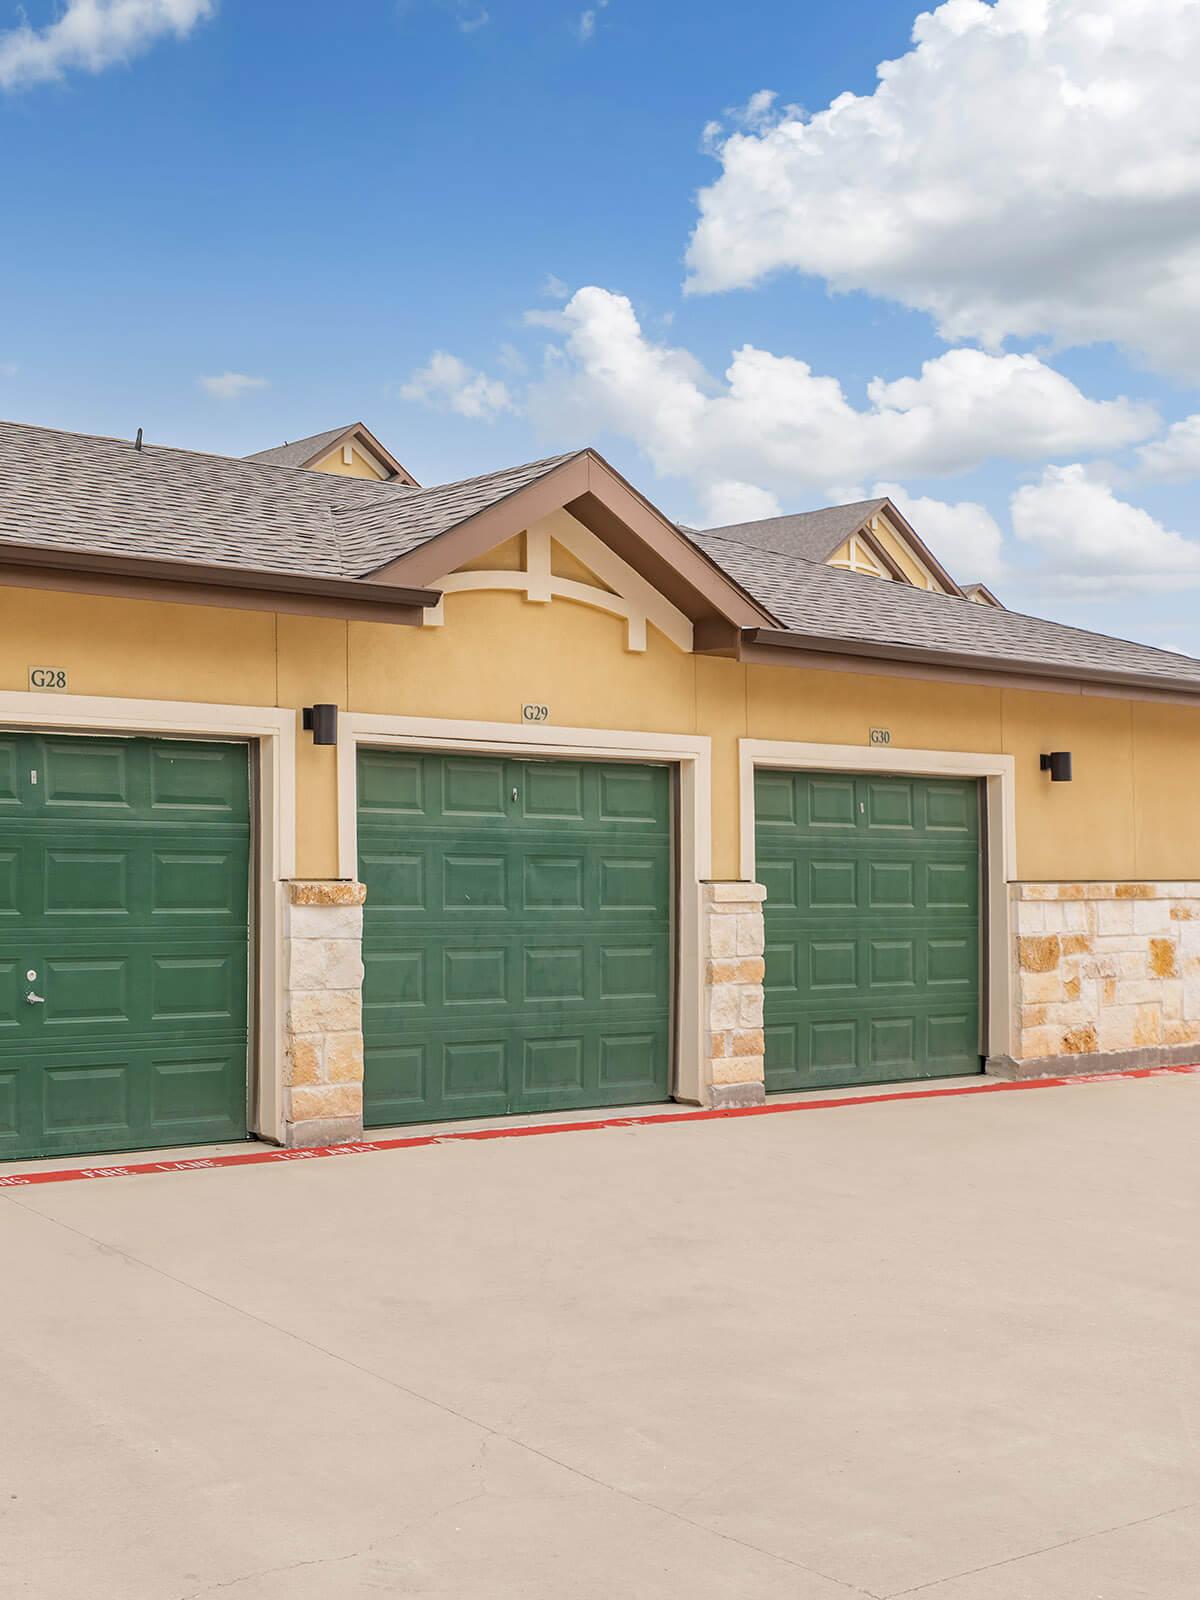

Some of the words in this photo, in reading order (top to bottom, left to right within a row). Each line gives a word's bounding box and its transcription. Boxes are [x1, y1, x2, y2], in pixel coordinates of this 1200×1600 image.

[31, 669, 66, 688] G28
[523, 705, 548, 721] G29
[871, 730, 890, 744] G30
[80, 1167, 136, 1179] FIRE
[155, 1159, 223, 1172] LANE
[325, 1143, 382, 1156] AWAY
